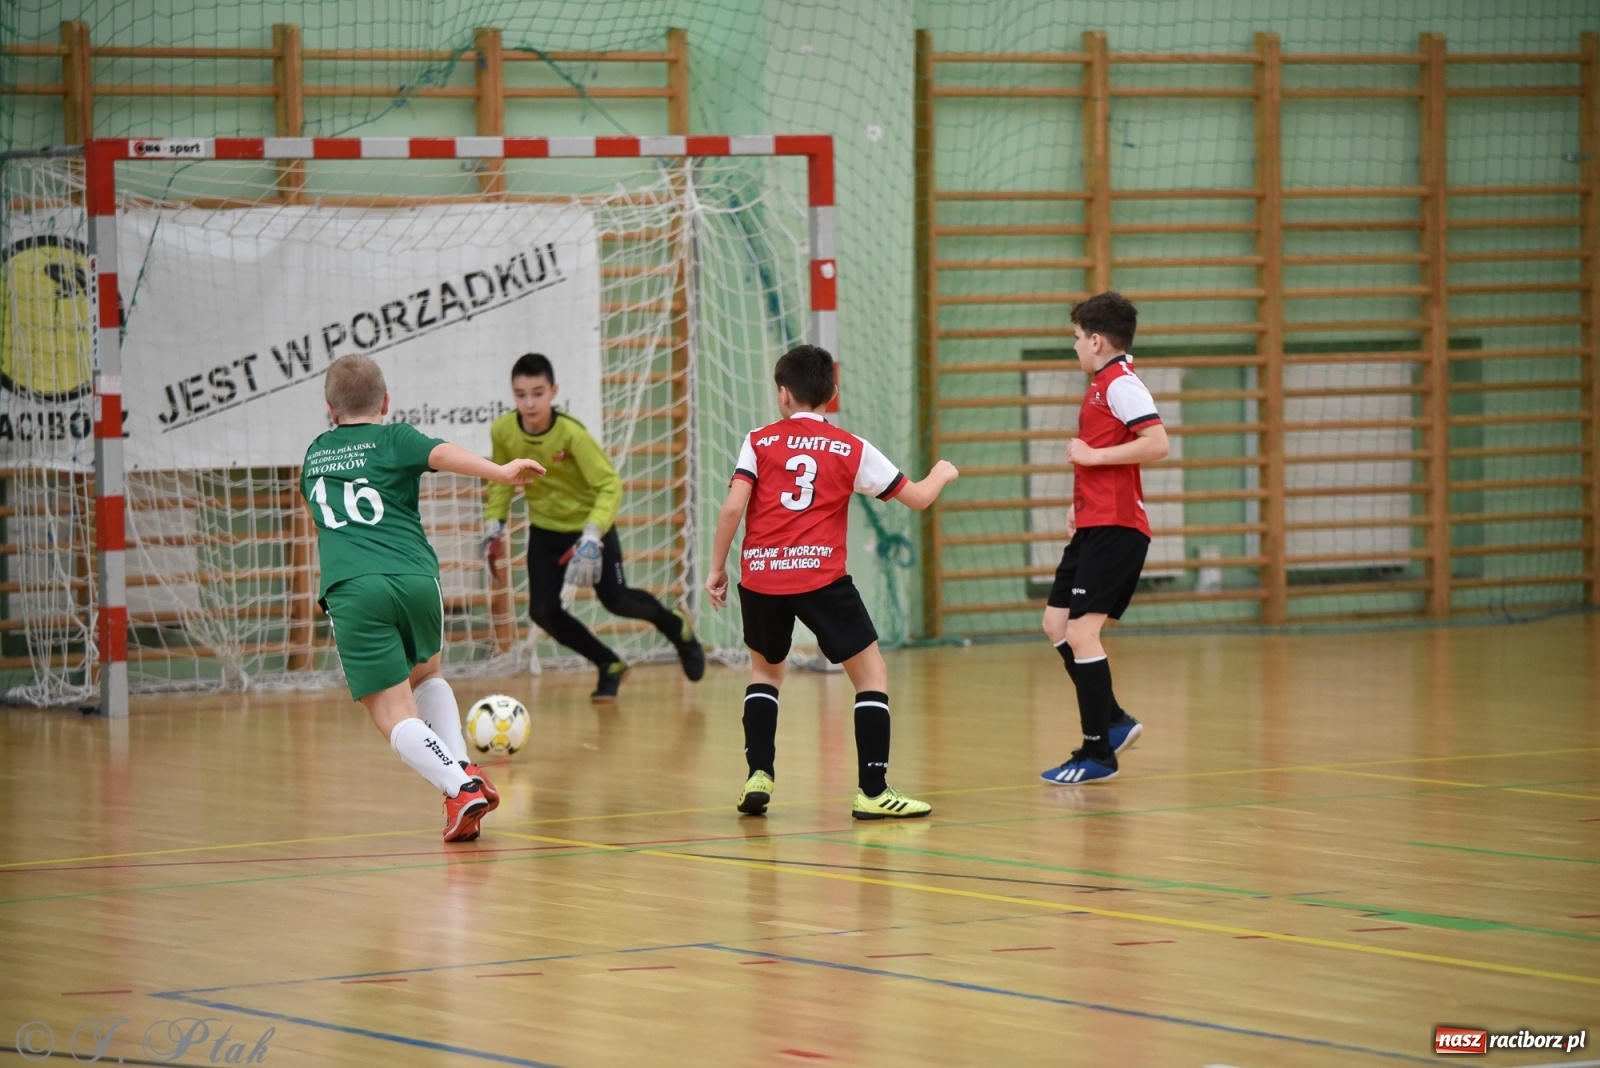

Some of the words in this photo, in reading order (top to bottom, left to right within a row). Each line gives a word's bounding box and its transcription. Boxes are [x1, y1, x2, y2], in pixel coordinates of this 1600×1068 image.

[169, 142, 200, 155] sport
[158, 353, 258, 425] JEST
[271, 334, 311, 379] W
[321, 243, 562, 360] PORZĄDKU!
[756, 435, 780, 447] AP
[787, 435, 851, 457] UNITED
[780, 453, 818, 512] 3
[309, 476, 384, 529] 16
[770, 558, 821, 571] WIELKIEGO
